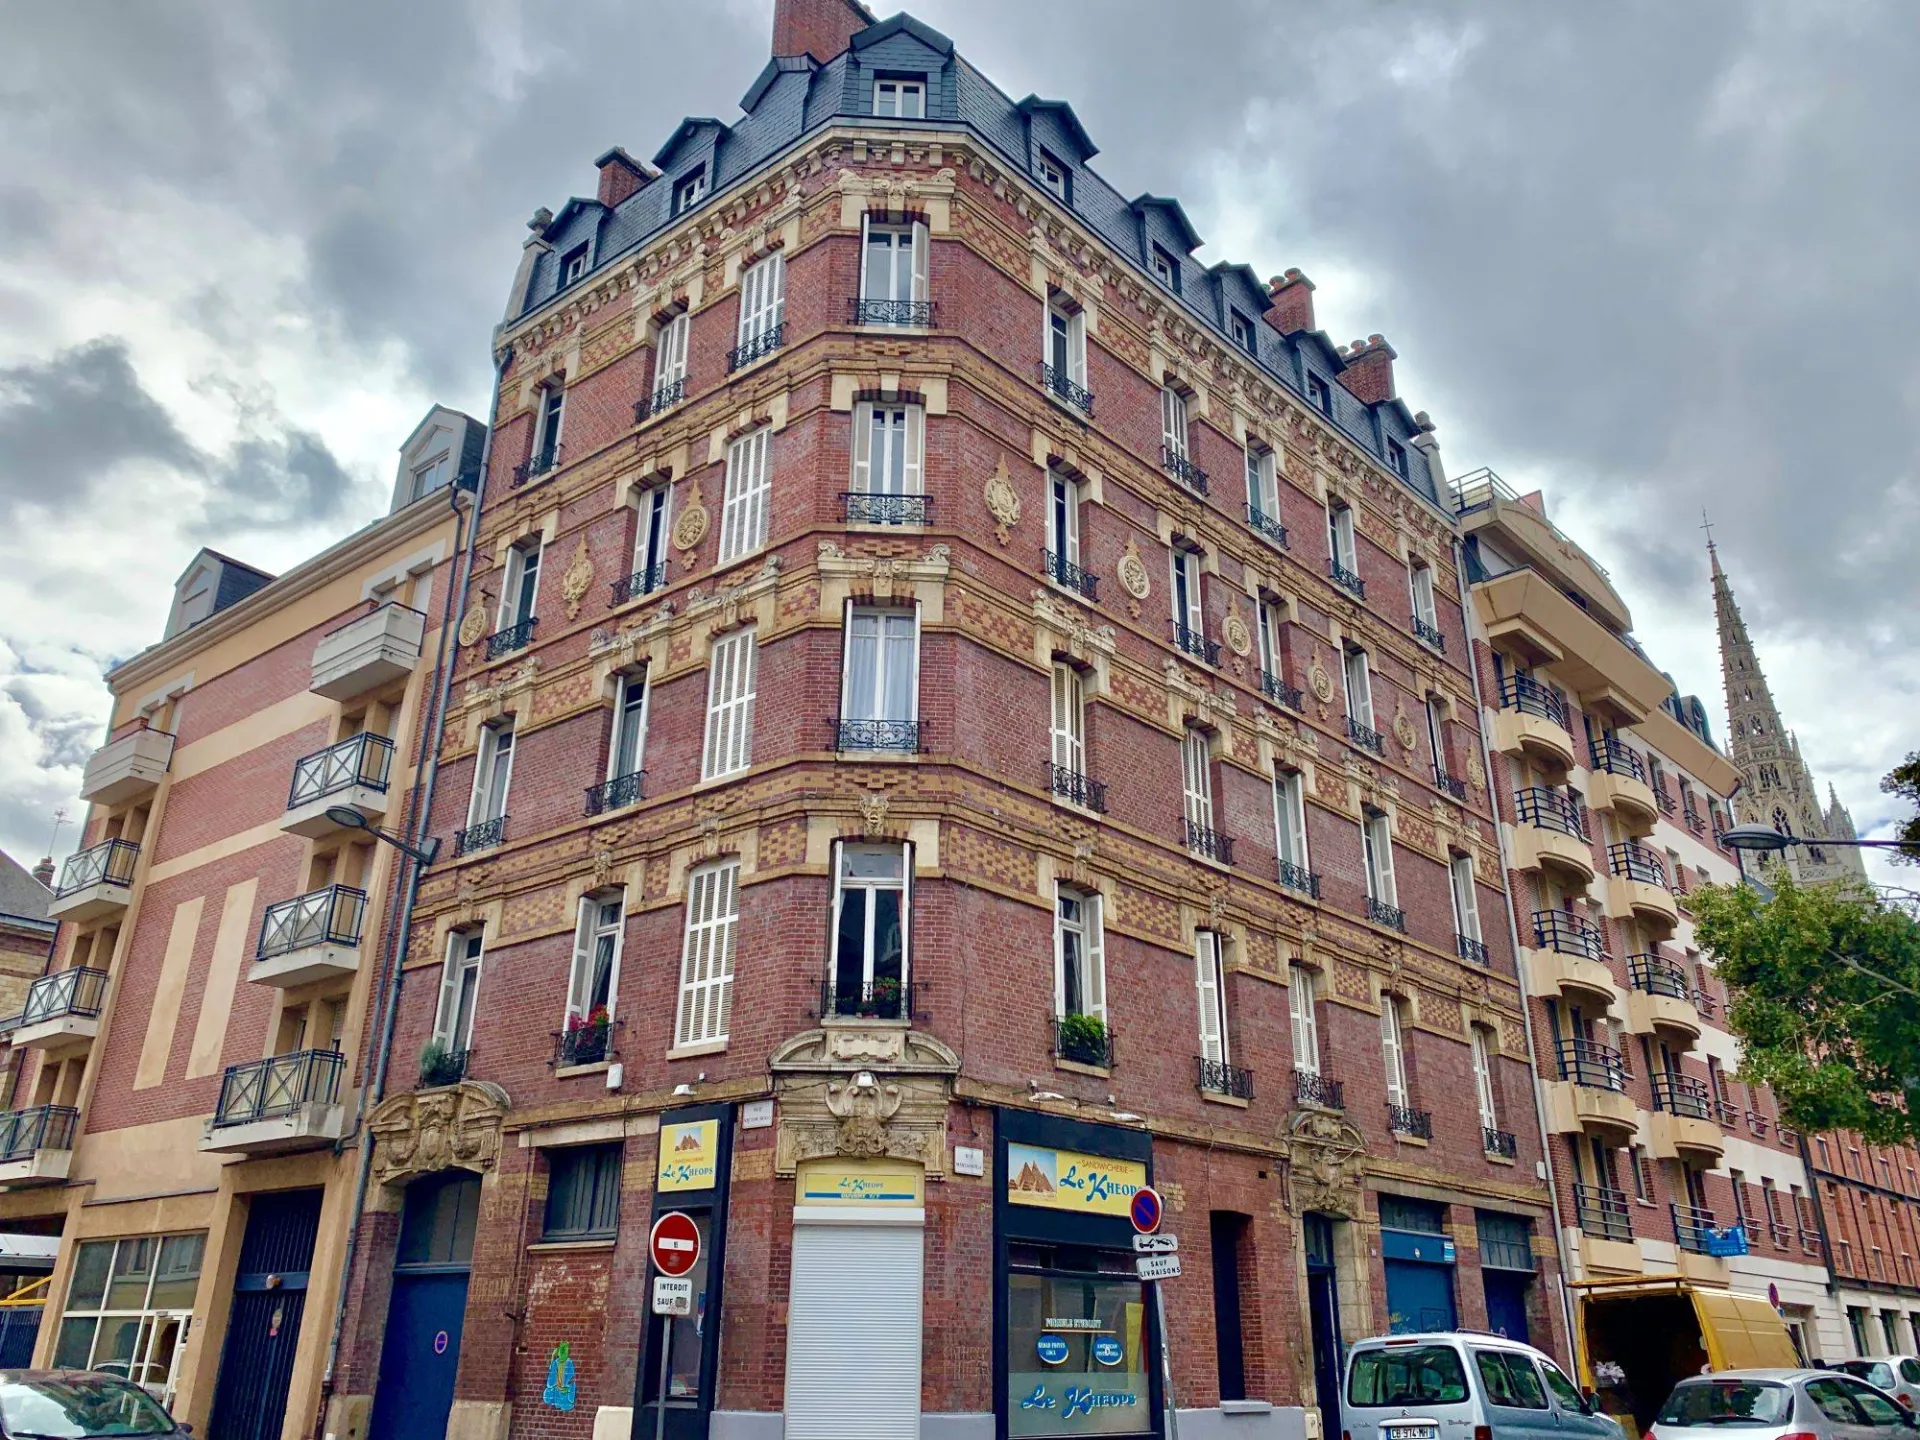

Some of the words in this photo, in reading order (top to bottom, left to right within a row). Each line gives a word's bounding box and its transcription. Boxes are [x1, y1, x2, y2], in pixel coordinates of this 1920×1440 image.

[1081, 1159, 1129, 1174] SANDWICHERIE
[660, 1164, 676, 1178] Le
[675, 1165, 713, 1184] KHEOPS
[837, 1176, 851, 1189] Le
[1059, 1165, 1085, 1189] Le
[1086, 1172, 1142, 1202] KHEOP
[1150, 1259, 1168, 1267] SAUF
[1140, 1266, 1181, 1276] LIVRAISONS
[660, 1283, 688, 1291] INTERDIT
[1021, 1384, 1056, 1409] Le
[1061, 1385, 1137, 1419] KHEOPS
